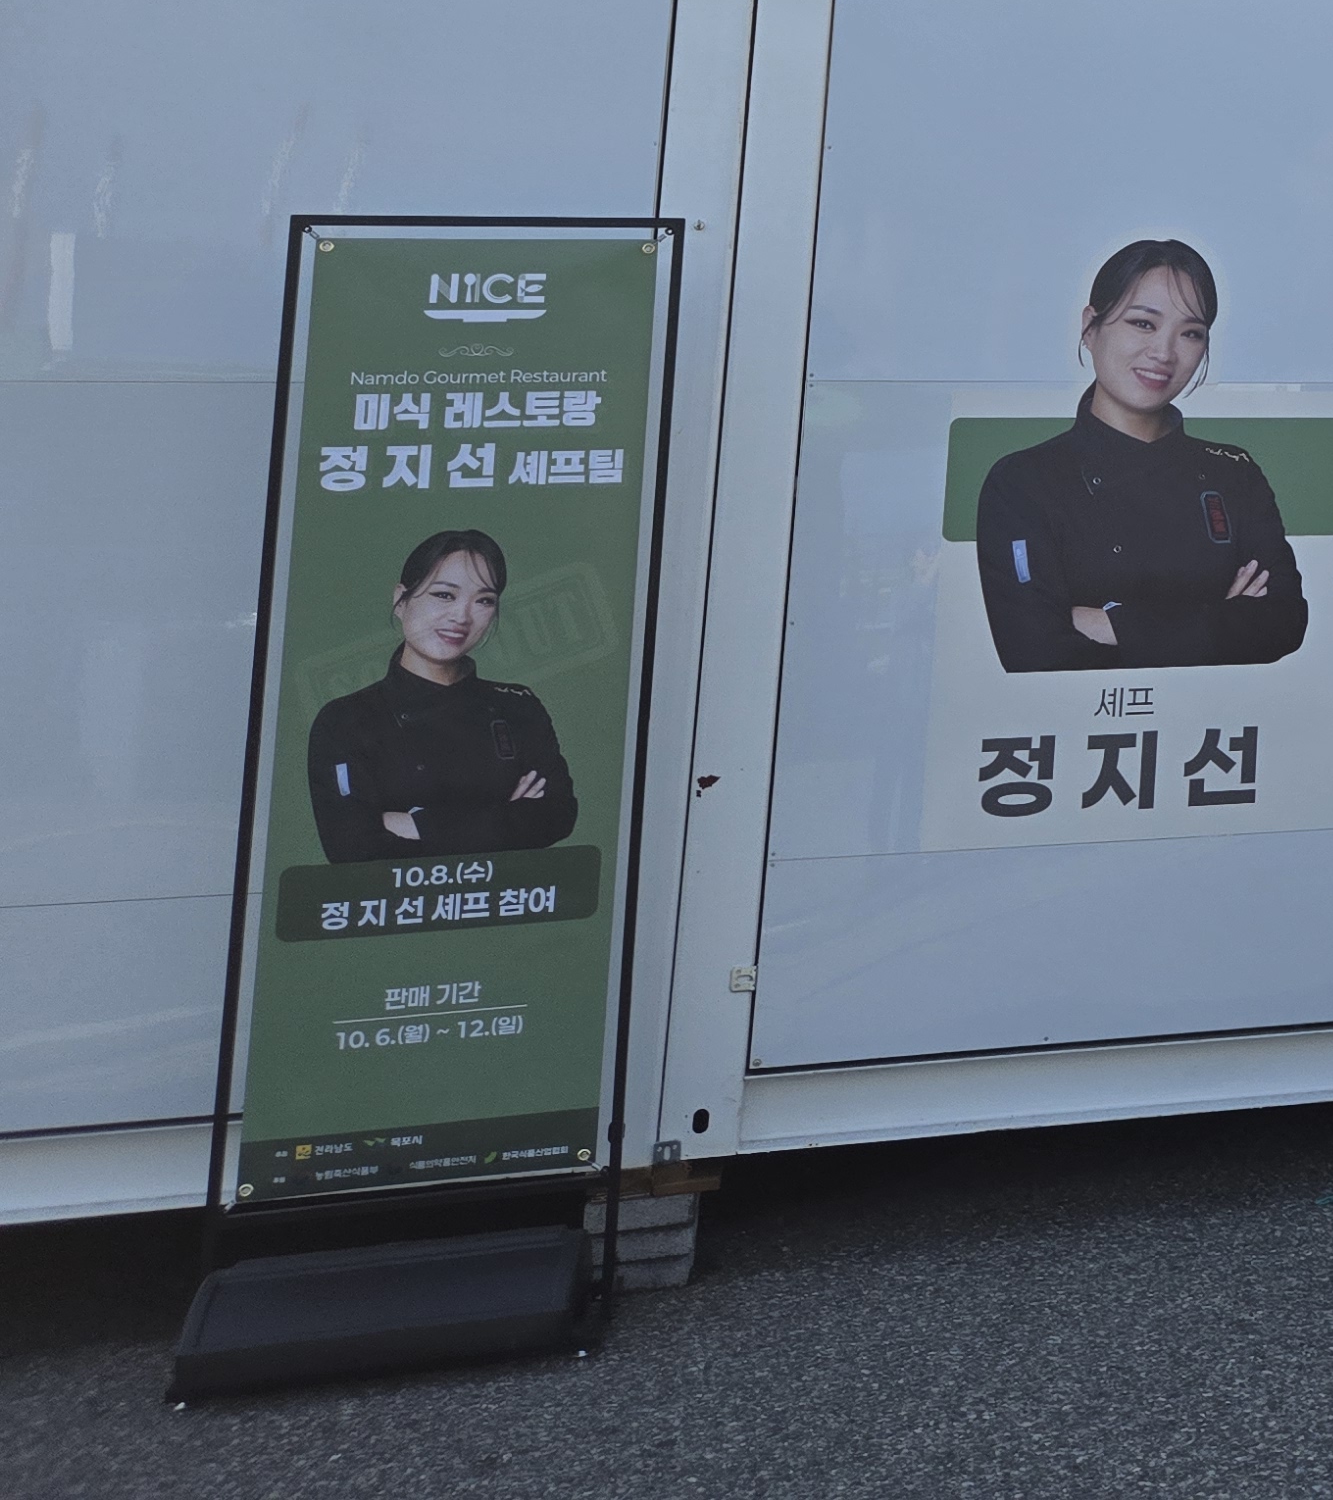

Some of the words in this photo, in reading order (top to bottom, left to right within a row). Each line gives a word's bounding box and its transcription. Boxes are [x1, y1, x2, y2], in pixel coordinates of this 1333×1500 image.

[350, 371, 420, 386] Namdo
[423, 370, 506, 385] Gourmet
[510, 368, 608, 384] Restaurant
[353, 392, 431, 431] 미식
[444, 390, 602, 429] 레스토랑
[508, 448, 624, 485] 셰프팀
[1094, 687, 1155, 718] 셰프
[392, 860, 494, 888] 10.8.(수)
[431, 891, 490, 922] 셰프
[498, 885, 557, 917] 참여
[384, 985, 430, 1011] 판매
[436, 980, 482, 1006] 기간
[458, 1015, 524, 1040] 12.(일)
